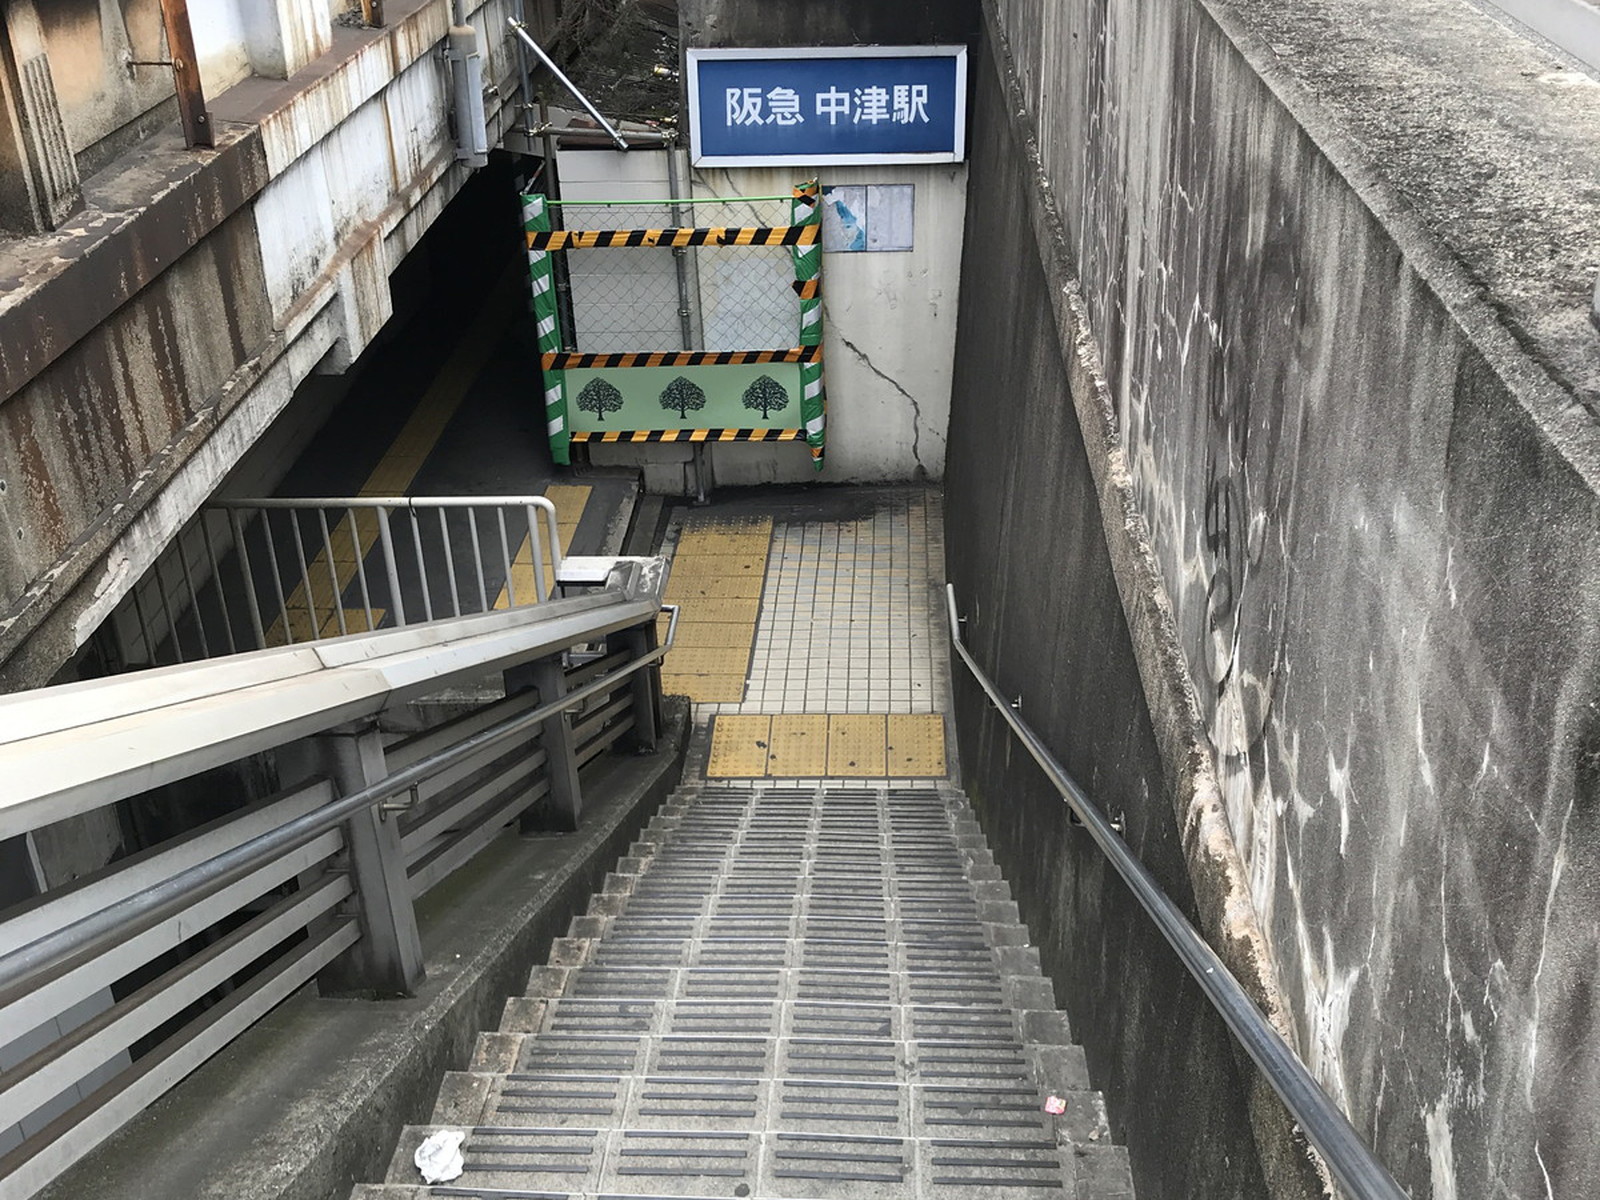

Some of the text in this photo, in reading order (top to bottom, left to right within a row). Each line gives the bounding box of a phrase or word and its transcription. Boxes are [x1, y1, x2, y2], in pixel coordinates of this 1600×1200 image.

[725, 84, 930, 126] 阪急 中津駅
